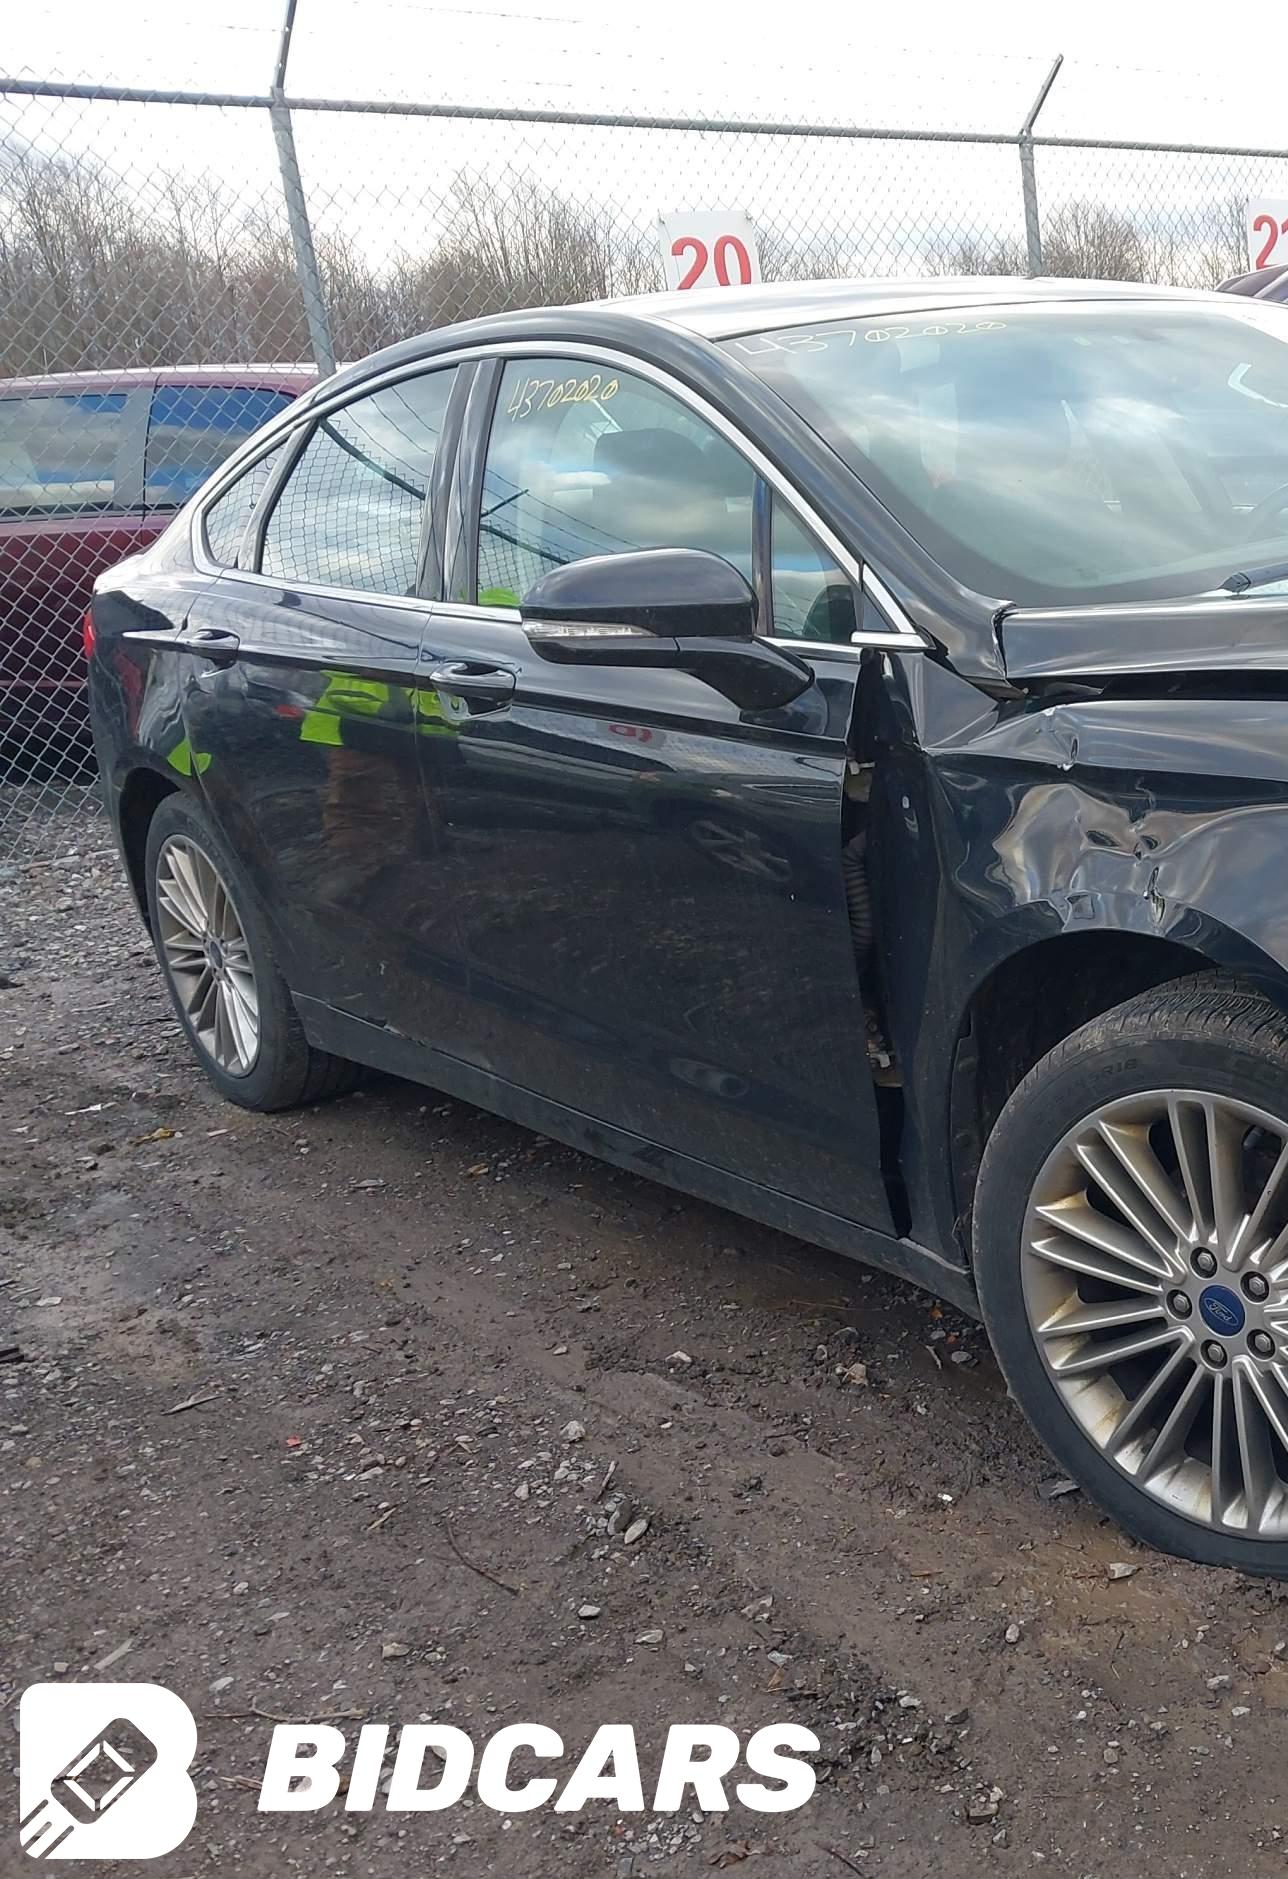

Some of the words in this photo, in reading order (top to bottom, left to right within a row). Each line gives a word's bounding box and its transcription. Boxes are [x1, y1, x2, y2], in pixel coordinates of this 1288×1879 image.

[671, 235, 752, 291] 20
[734, 320, 1007, 355] 43702020
[507, 374, 619, 422] 43702020
